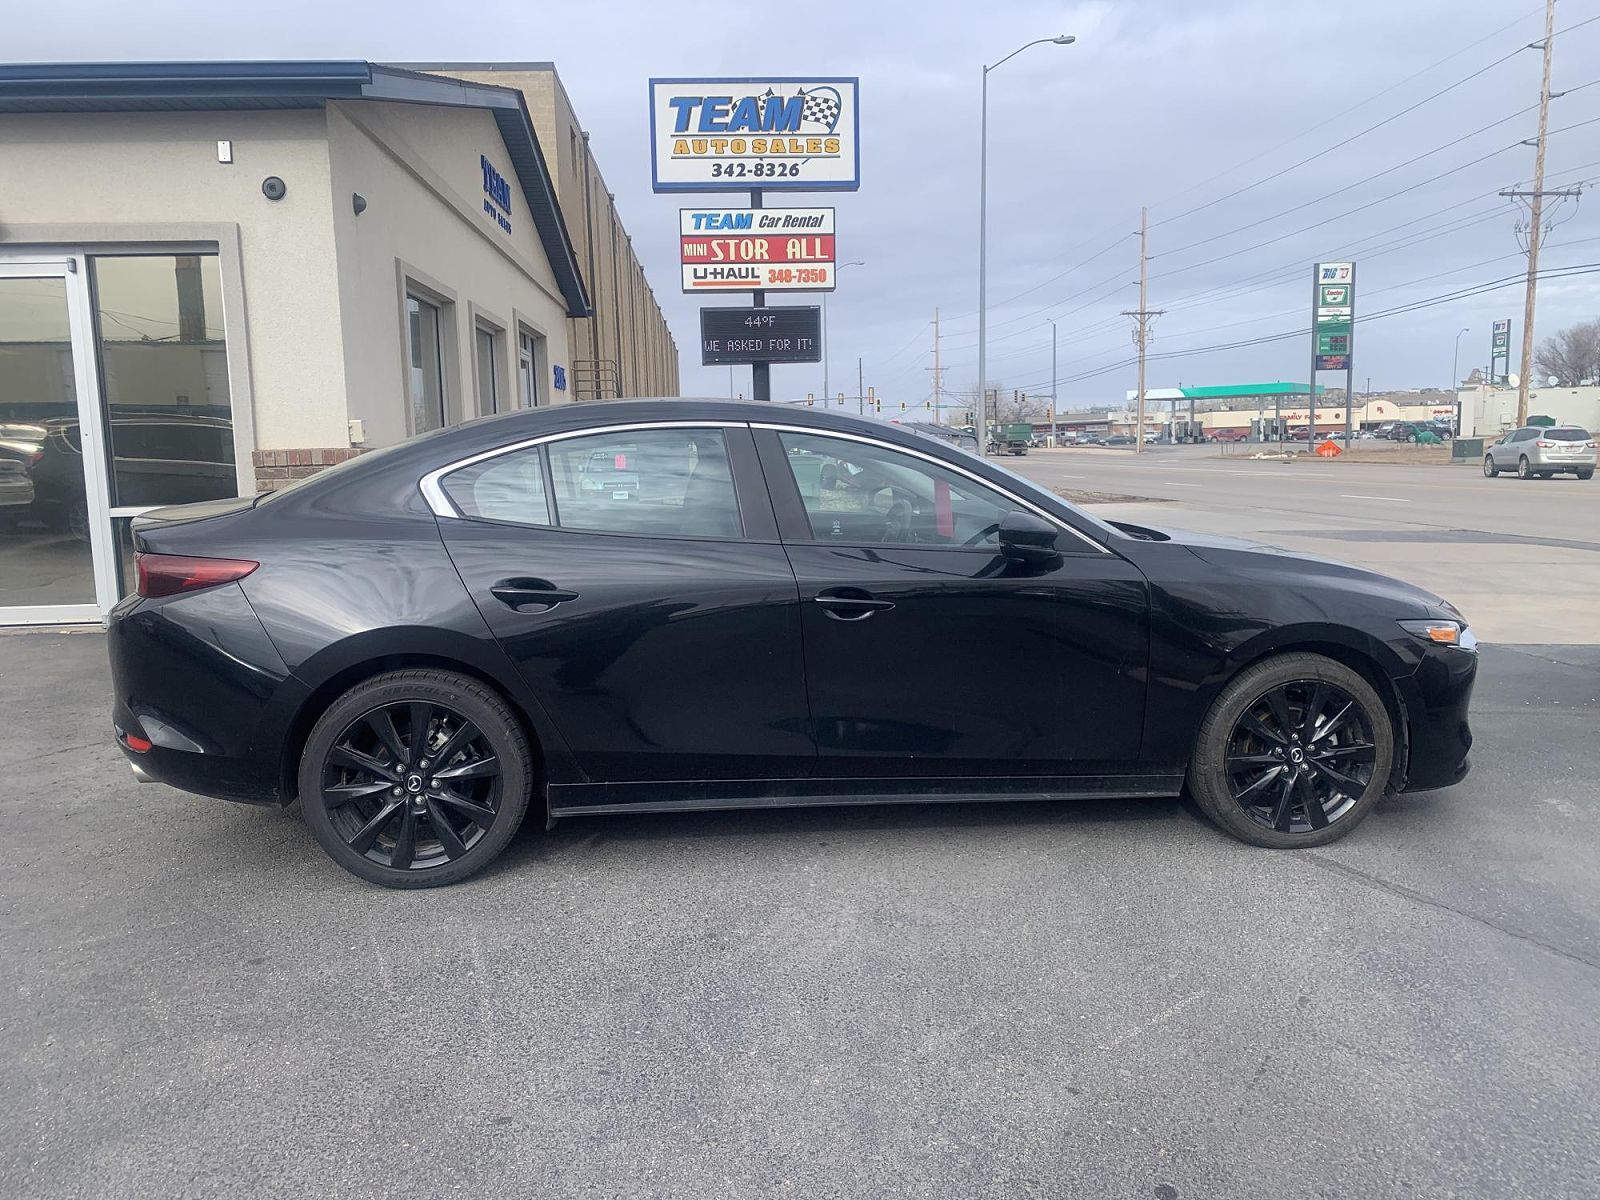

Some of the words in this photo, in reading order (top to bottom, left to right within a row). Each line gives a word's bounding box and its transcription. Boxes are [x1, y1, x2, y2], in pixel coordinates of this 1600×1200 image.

[669, 96, 805, 133] TEAM
[673, 138, 747, 155] AUTO
[752, 138, 840, 154] SALES
[711, 163, 800, 178] 342-8326
[481, 154, 512, 215] TEAM
[691, 213, 754, 230] TEAM
[758, 215, 783, 228] Car
[782, 214, 825, 228] Rental
[683, 243, 707, 257] MINI
[710, 238, 770, 261] STOR
[786, 238, 829, 260] ALL
[693, 267, 760, 280] U-HAUL
[768, 268, 827, 284] 348-7350
[704, 340, 720, 352] WE
[727, 339, 763, 351] ASKED
[769, 338, 791, 350] FOR
[797, 338, 812, 350] IT!
